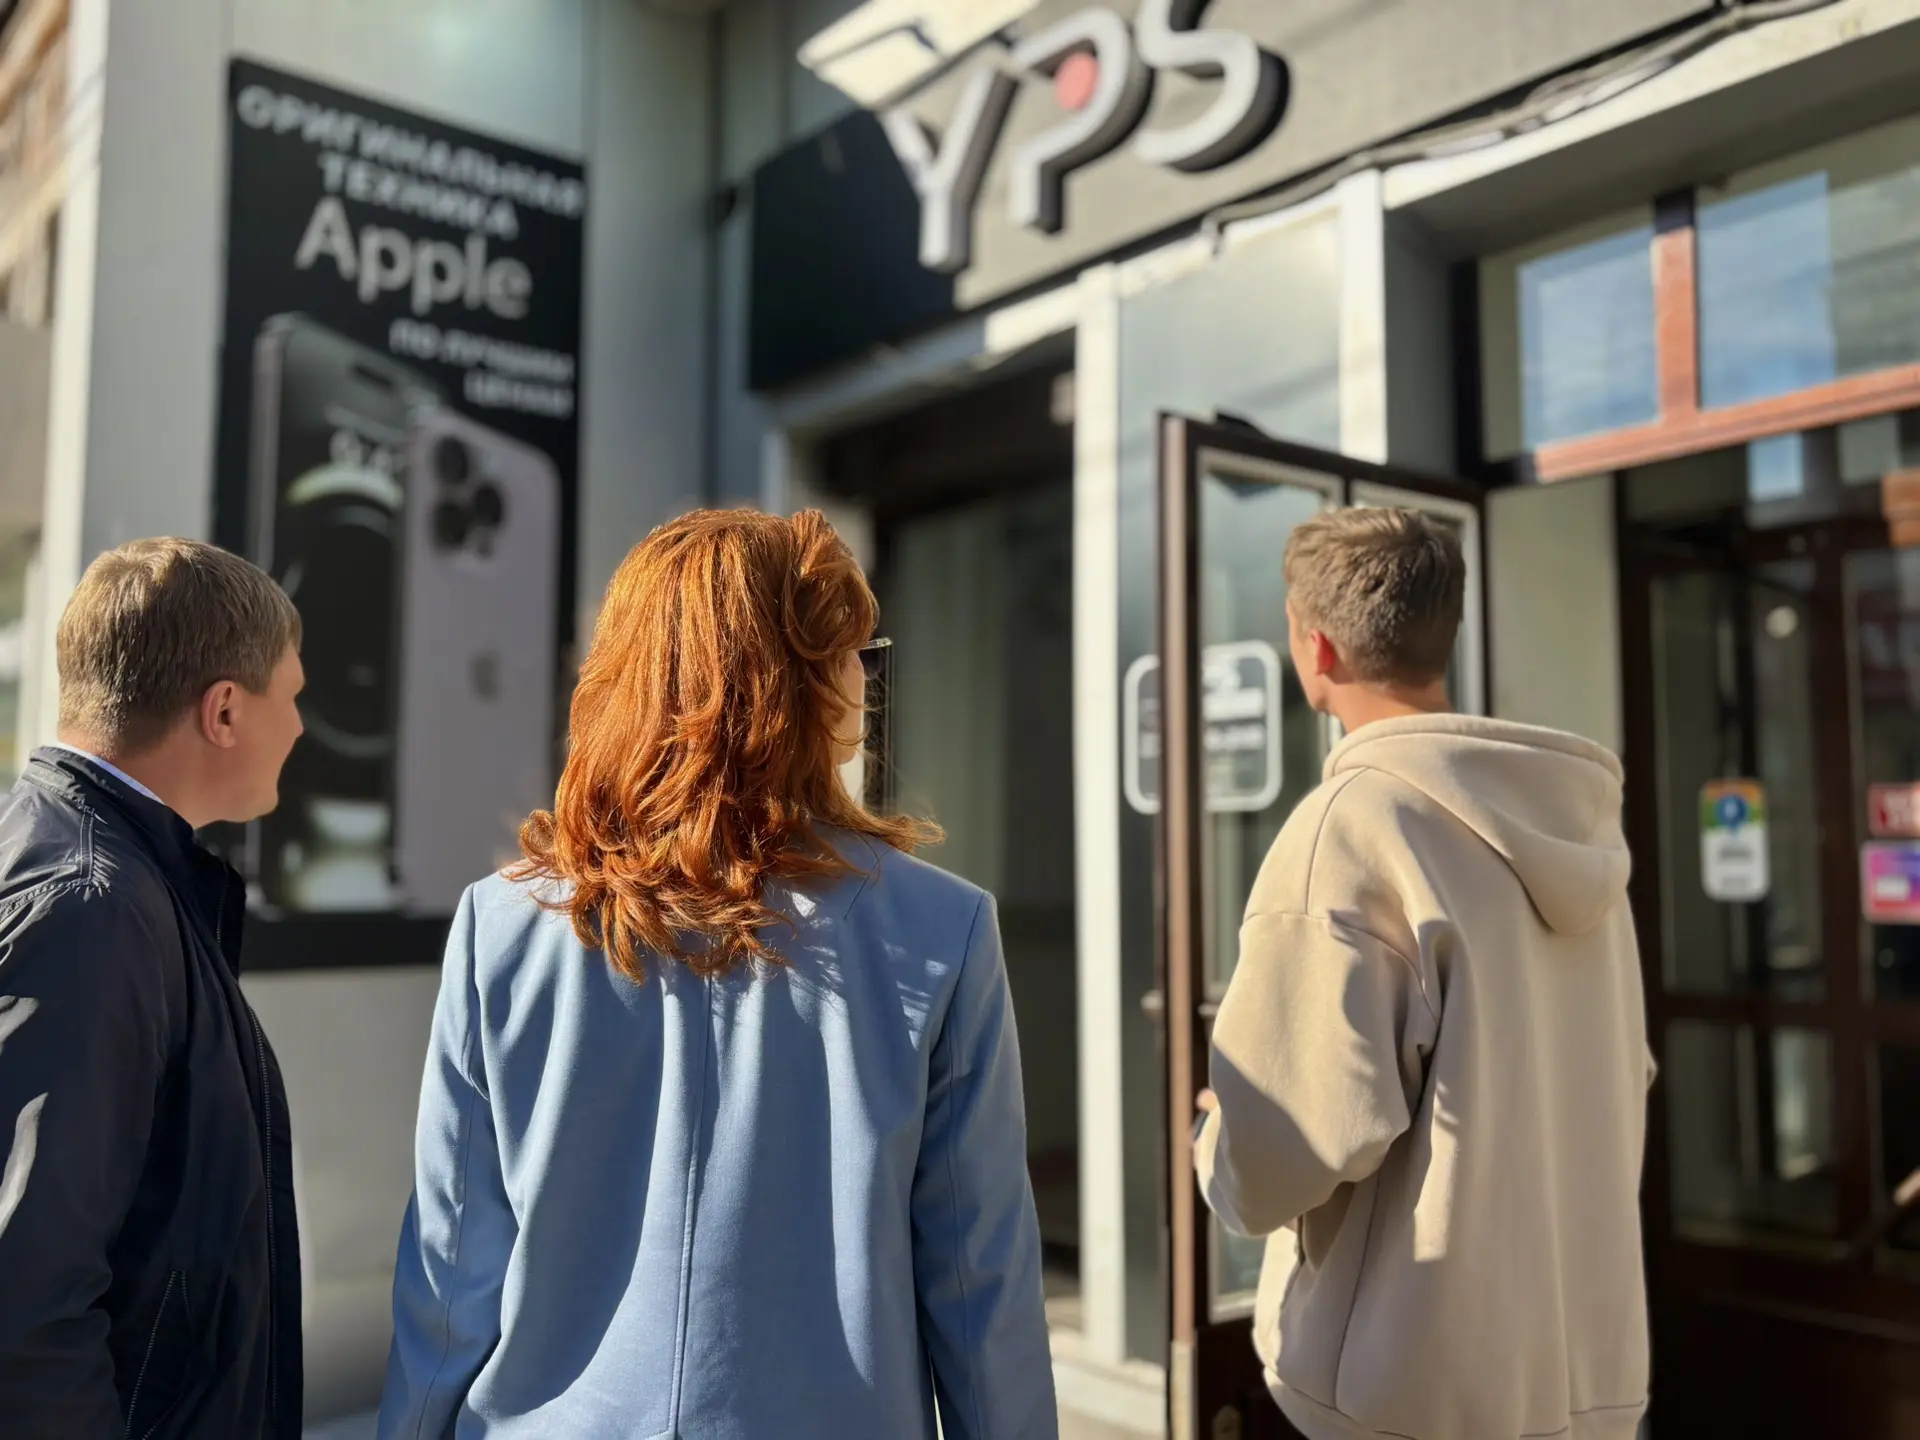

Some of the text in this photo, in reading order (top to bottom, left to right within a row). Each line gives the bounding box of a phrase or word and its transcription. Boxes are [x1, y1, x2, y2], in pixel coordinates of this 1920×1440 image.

[237, 85, 583, 219] ОРИГИНАЛЬНАЯ
[318, 152, 519, 240] ТЕХНИКА
[294, 195, 532, 320] Apple
